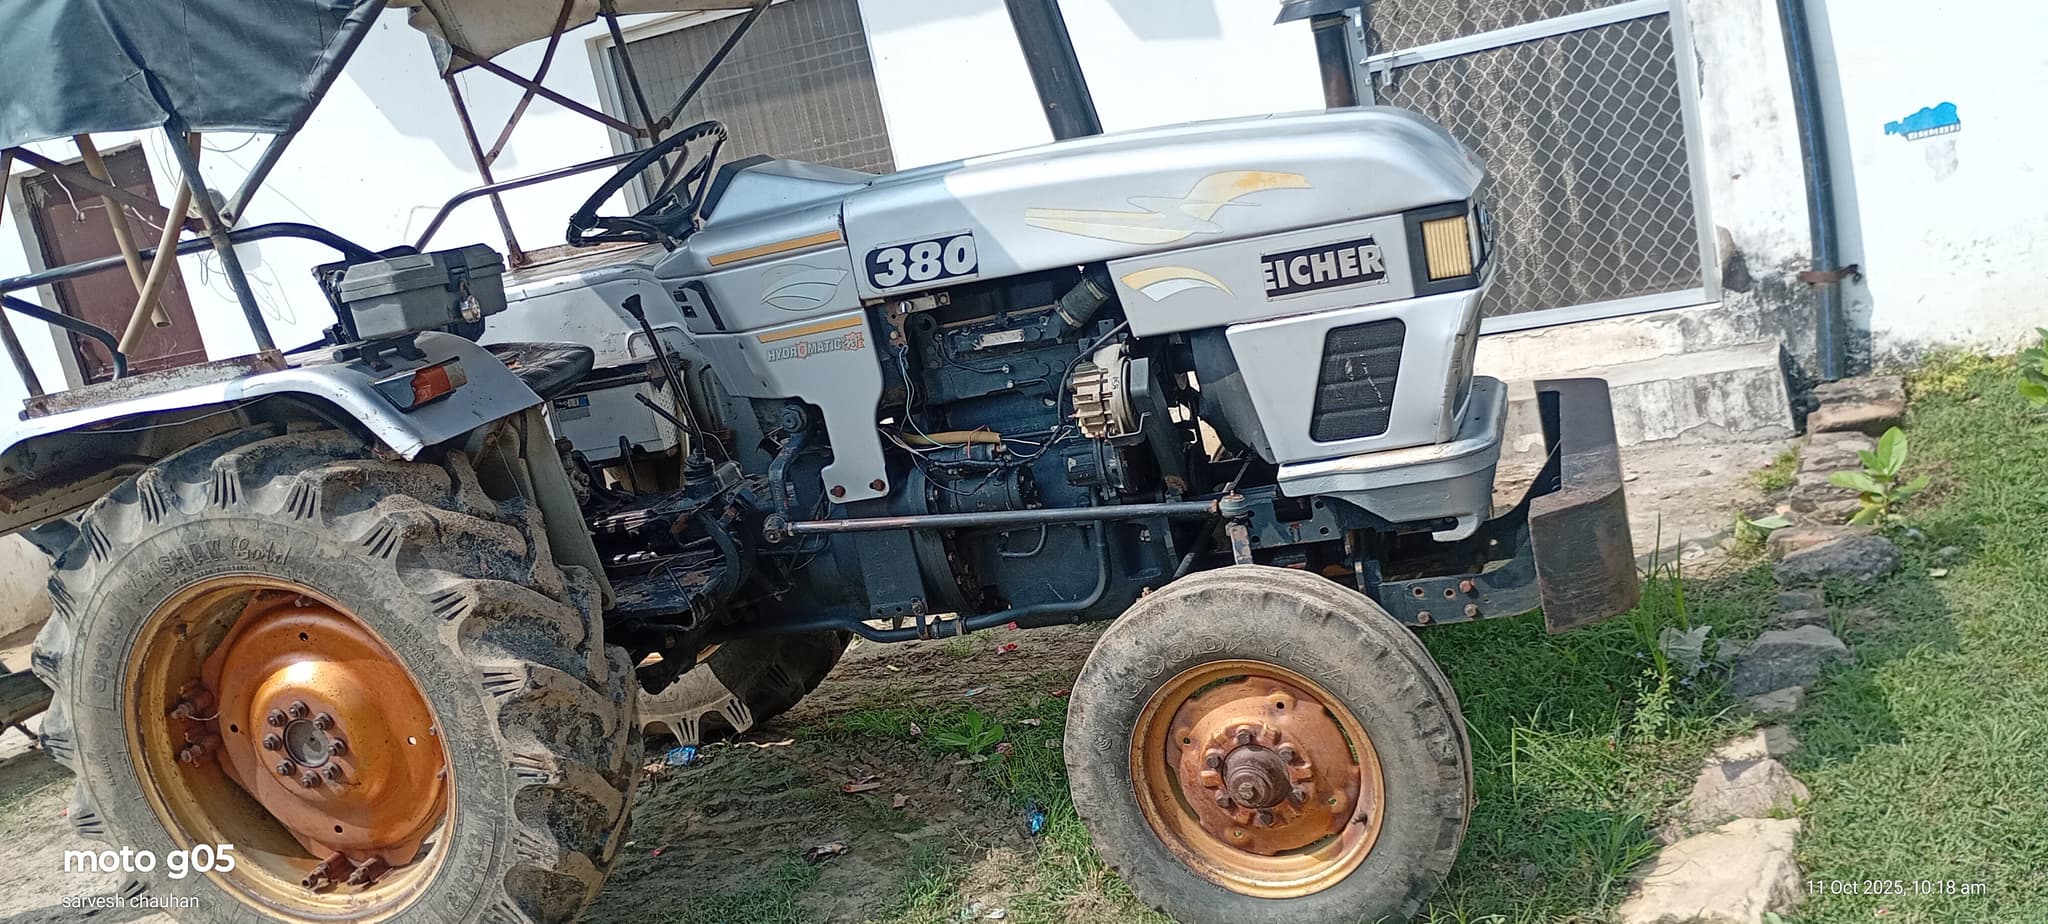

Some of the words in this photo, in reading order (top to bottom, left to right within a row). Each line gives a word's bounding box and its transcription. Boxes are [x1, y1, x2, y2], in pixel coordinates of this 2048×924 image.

[873, 235, 977, 287] 380
[1261, 244, 1385, 290] EICHER
[767, 338, 843, 362] HYDROMATIC
